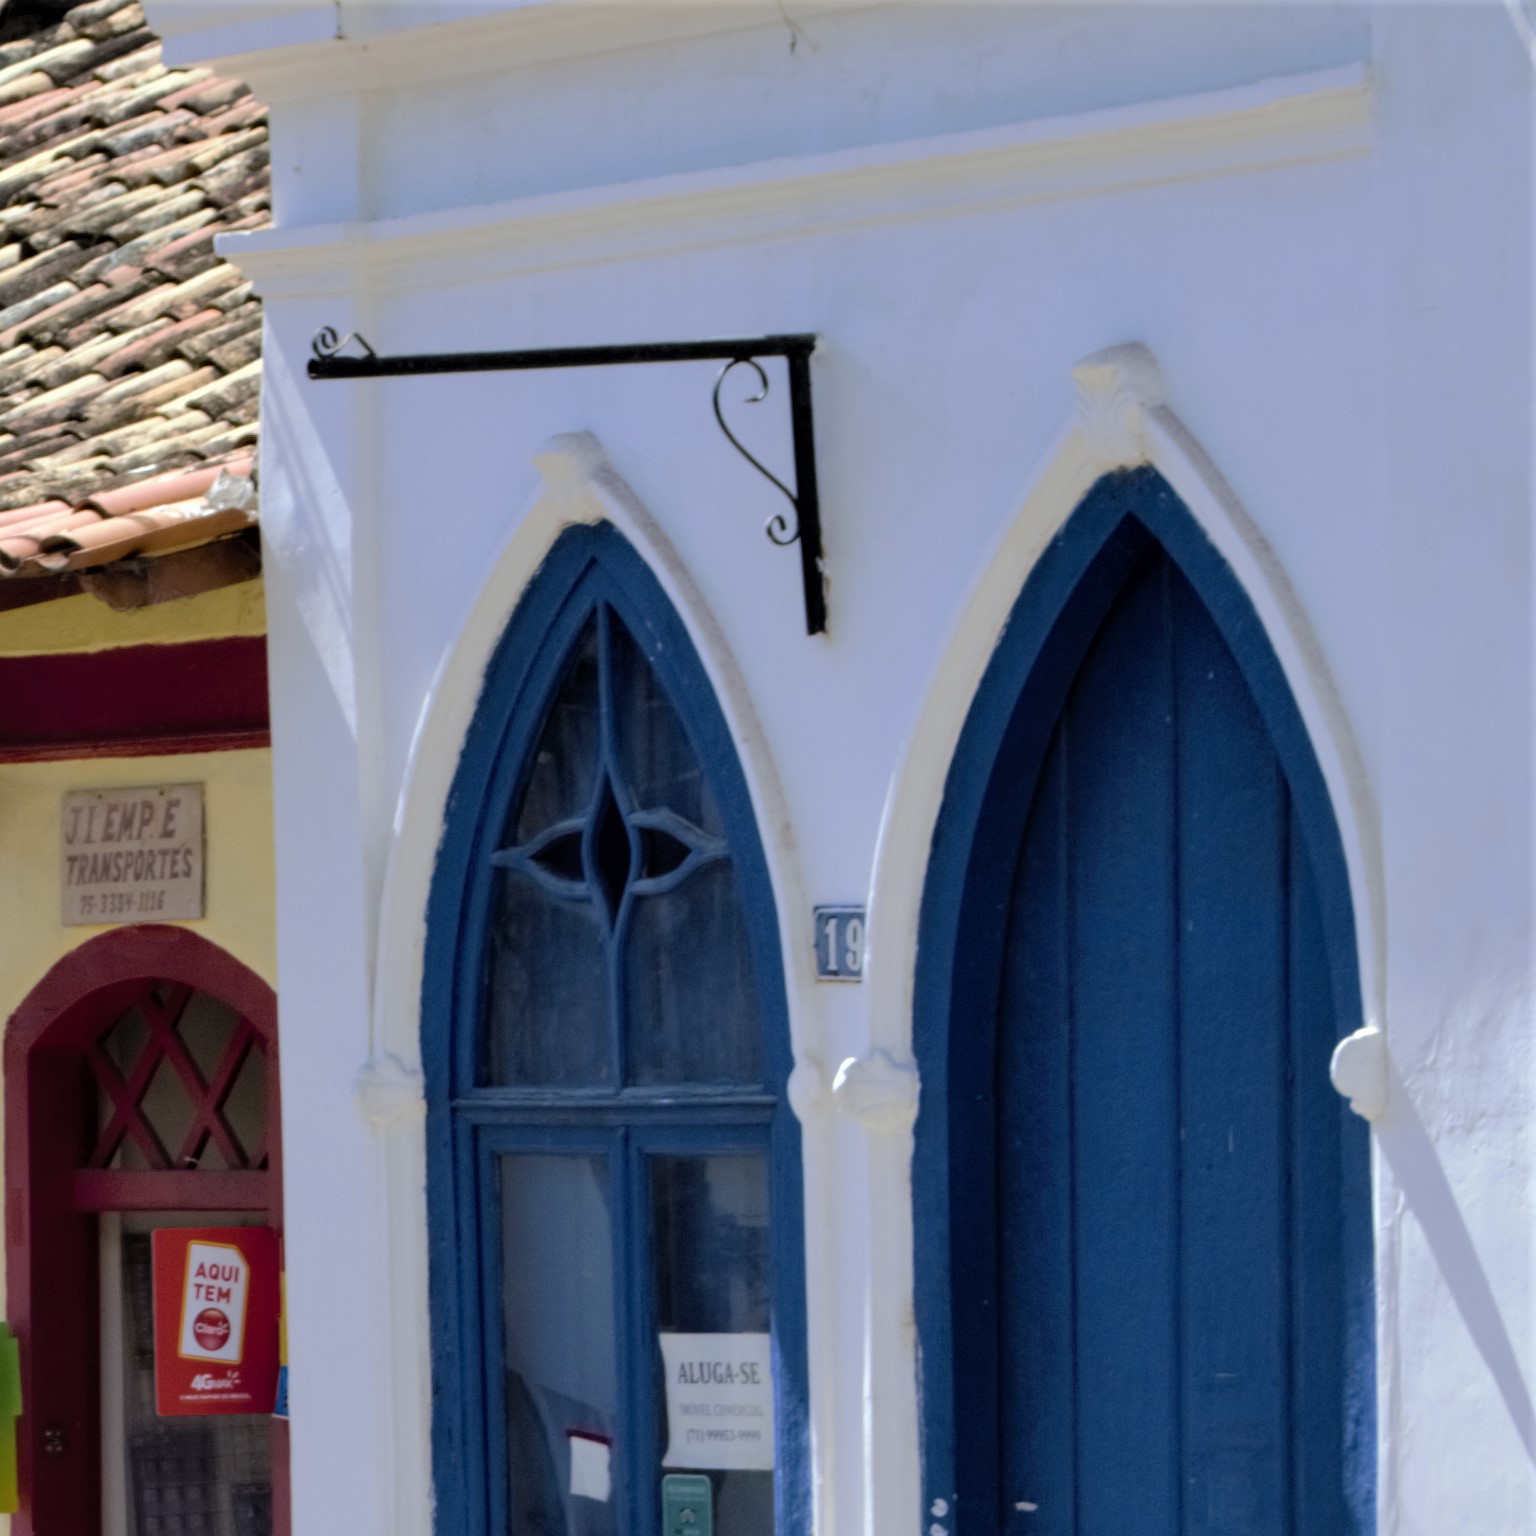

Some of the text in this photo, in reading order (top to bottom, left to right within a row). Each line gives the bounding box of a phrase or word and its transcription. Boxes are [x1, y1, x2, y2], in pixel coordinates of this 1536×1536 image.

[66, 846, 194, 886] TRANSPORTES
[824, 917, 864, 972] 19
[194, 1262, 240, 1284] AQUI
[193, 1282, 232, 1304] TEM
[676, 1361, 762, 1385] ALUGA-SE
